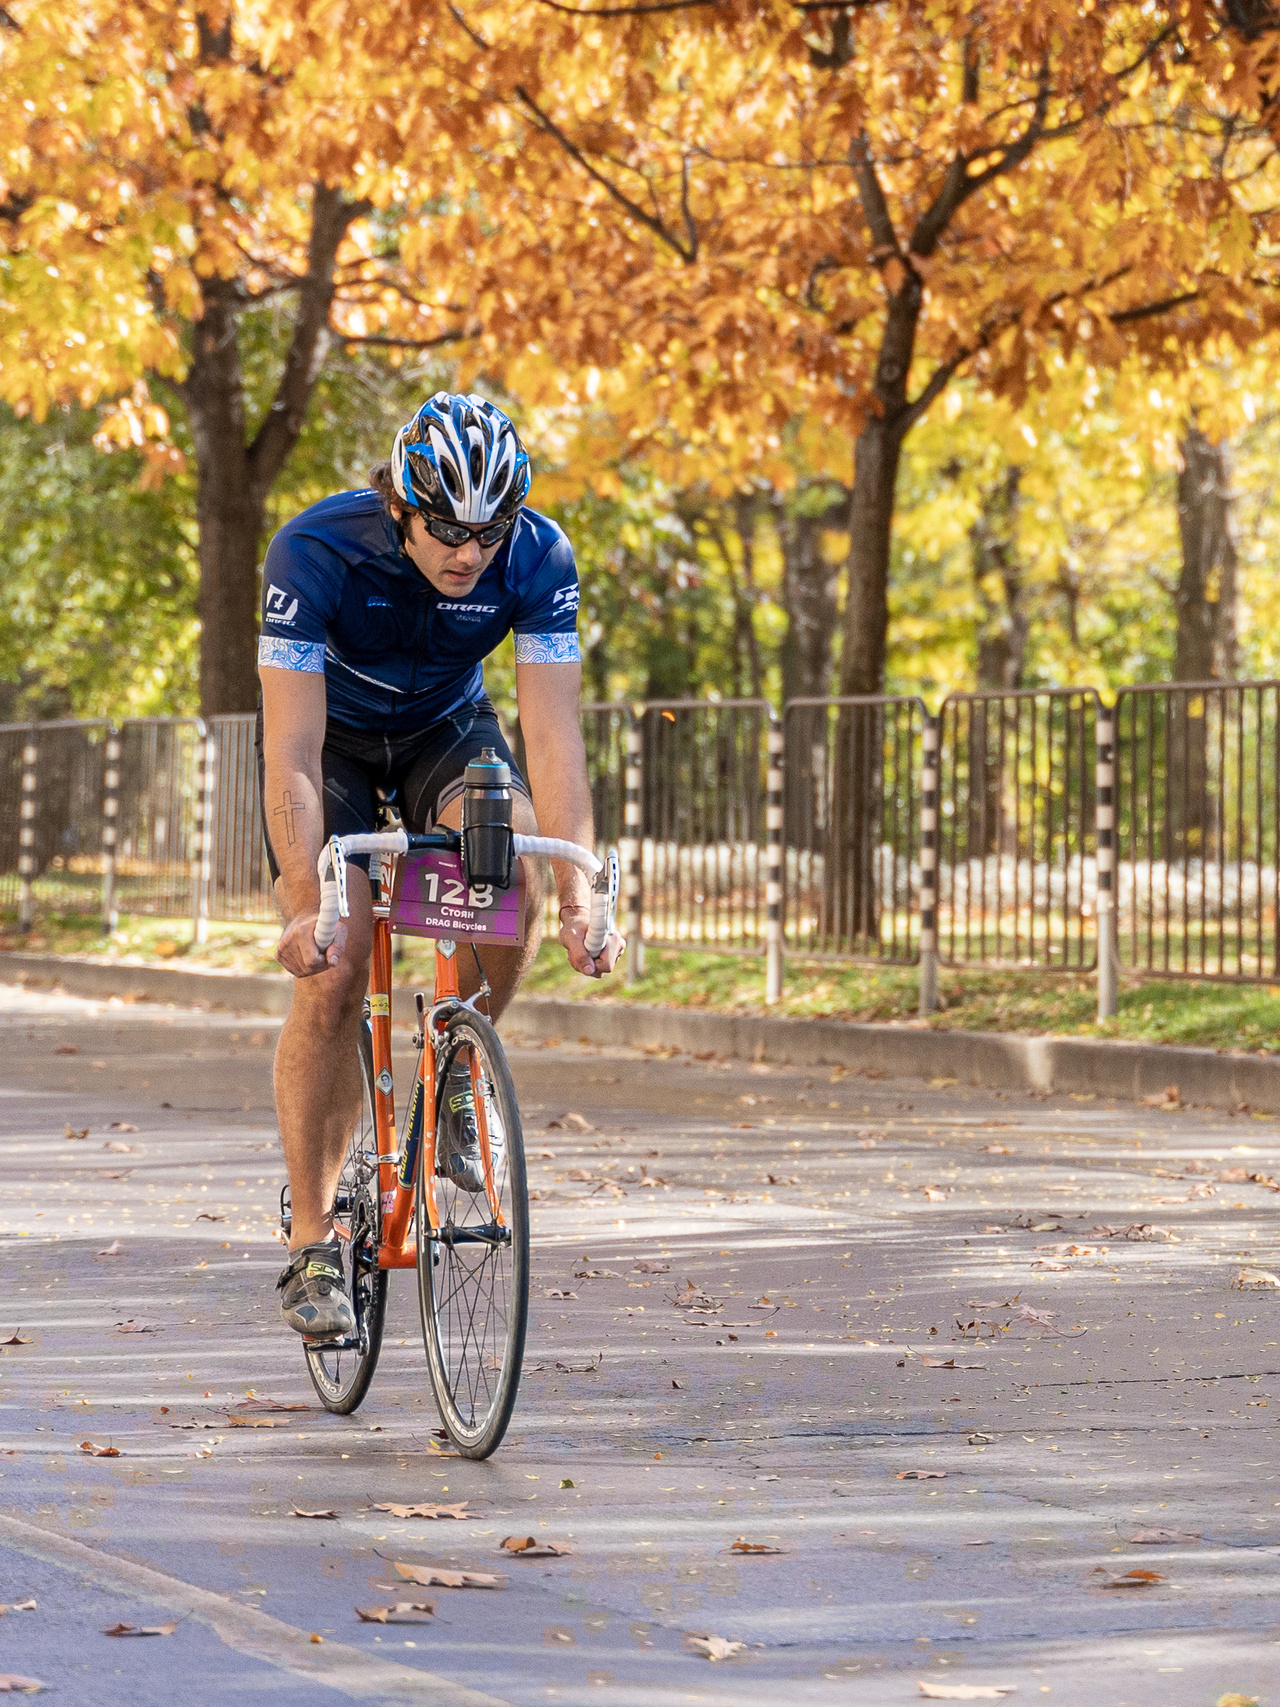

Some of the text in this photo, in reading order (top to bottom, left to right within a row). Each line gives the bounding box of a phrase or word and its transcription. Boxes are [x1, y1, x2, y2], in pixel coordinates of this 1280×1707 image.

[436, 602, 499, 613] DRAG
[265, 617, 297, 627] DRAG
[424, 873, 494, 909] 12B
[440, 906, 475, 919] Стоян
[425, 917, 487, 931] DRAG Bicycles
